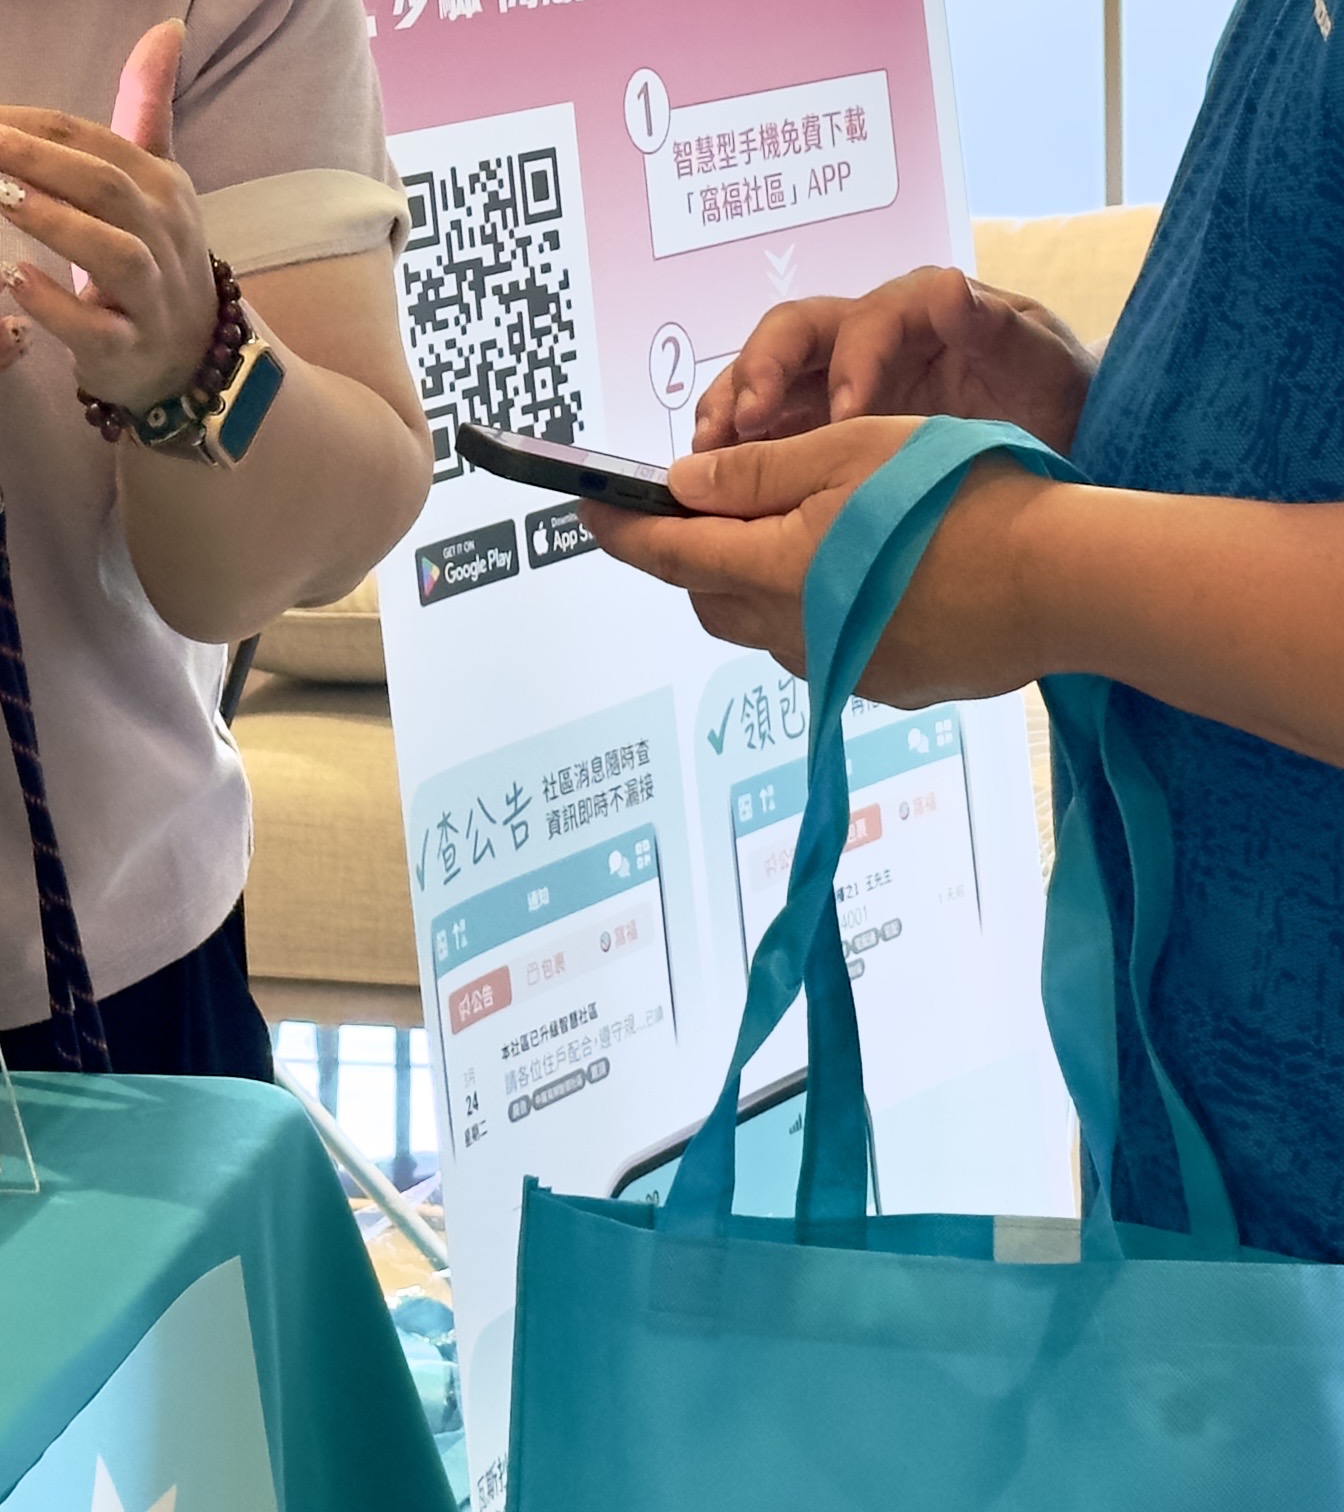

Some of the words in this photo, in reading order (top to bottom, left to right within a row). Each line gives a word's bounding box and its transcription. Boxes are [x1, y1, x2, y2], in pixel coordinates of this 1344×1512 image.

[637, 81, 654, 138] 1
[672, 104, 868, 180] 智慧型手機免費下載
[686, 172, 798, 226] 「窩福社區」
[807, 160, 852, 199] APP
[661, 336, 685, 395] 2
[442, 544, 456, 560] GET
[463, 539, 475, 553] ON
[444, 553, 488, 584] Google
[487, 548, 513, 571] Play
[553, 529, 578, 553] App
[541, 738, 651, 804] 社區消息隨時查
[435, 780, 533, 886] 查公告
[545, 772, 655, 840] 資訊即時不漏接
[500, 1001, 599, 1060] 本社區已升級智慧社區
[465, 1090, 479, 1117] 24
